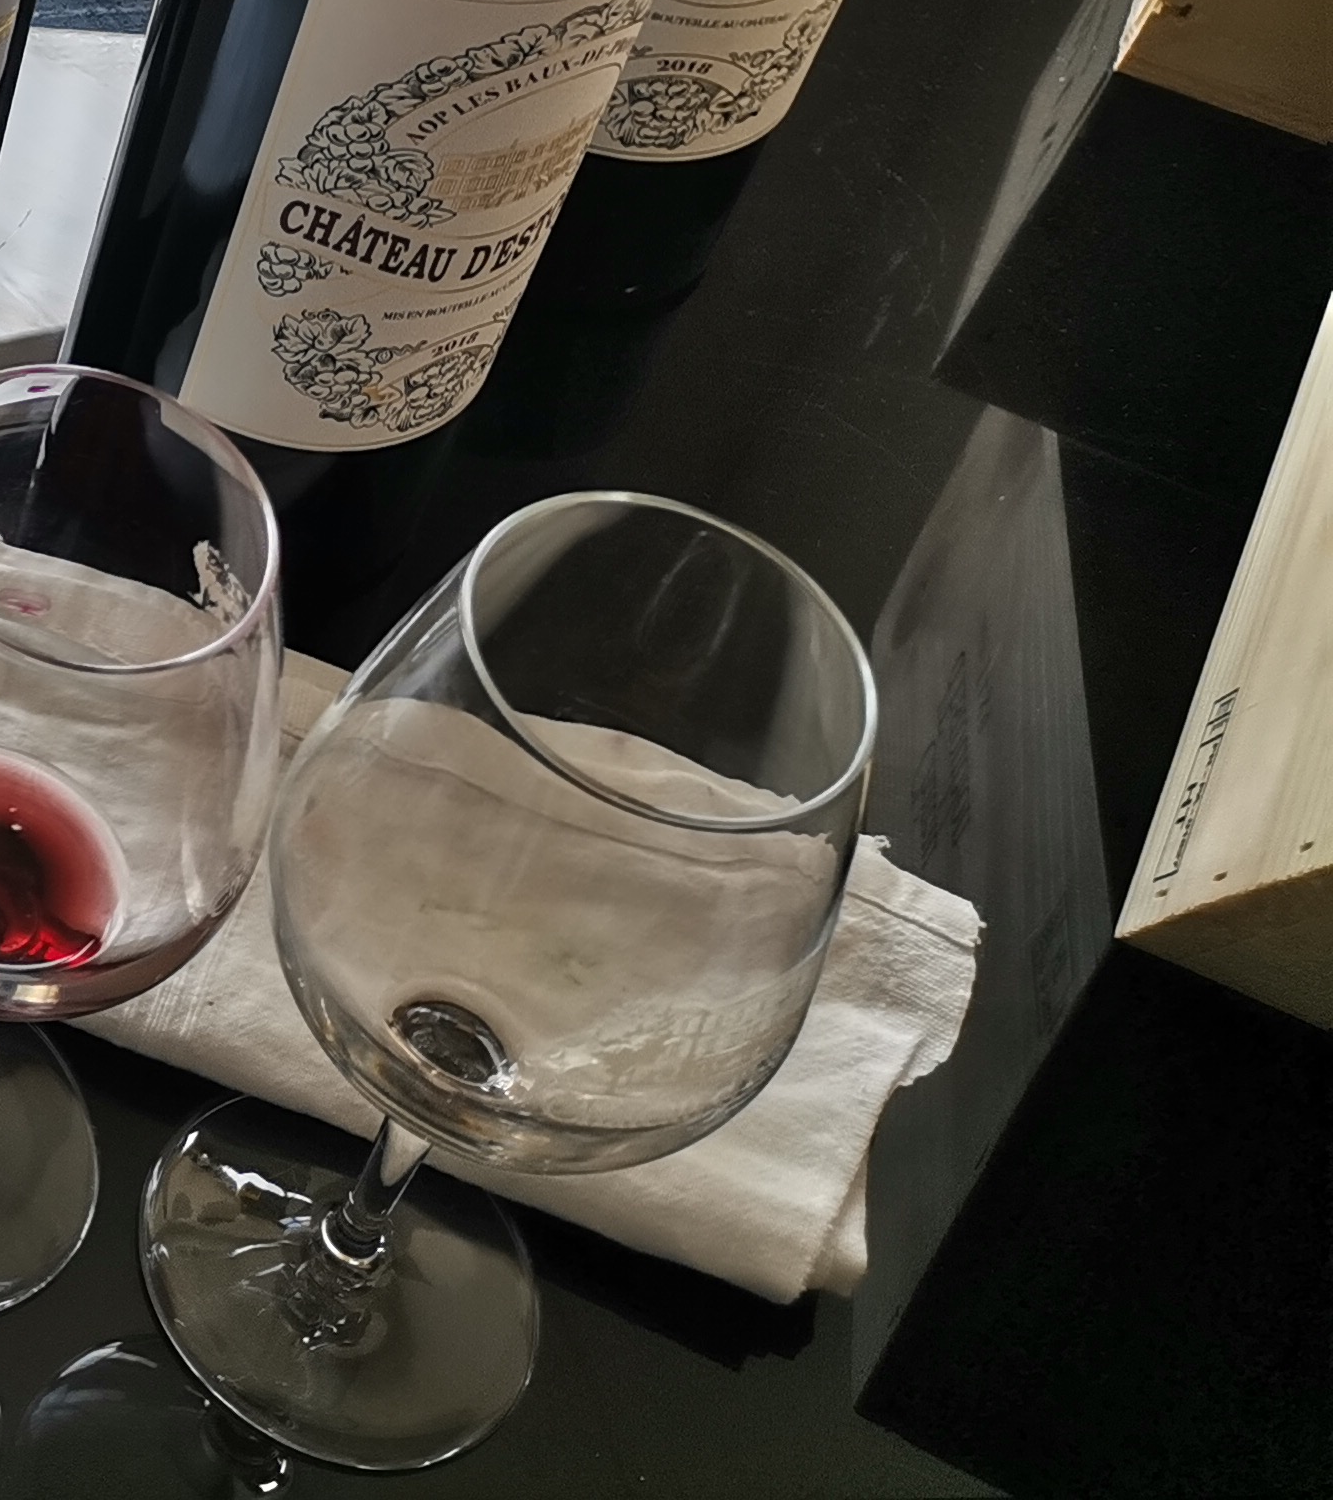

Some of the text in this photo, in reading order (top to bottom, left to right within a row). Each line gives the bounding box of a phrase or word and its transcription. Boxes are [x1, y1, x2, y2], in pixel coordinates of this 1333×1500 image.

[656, 58, 713, 75] 2018
[405, 110, 450, 146] AOP
[452, 85, 501, 116] LES
[279, 200, 459, 284] CHÂTEAU
